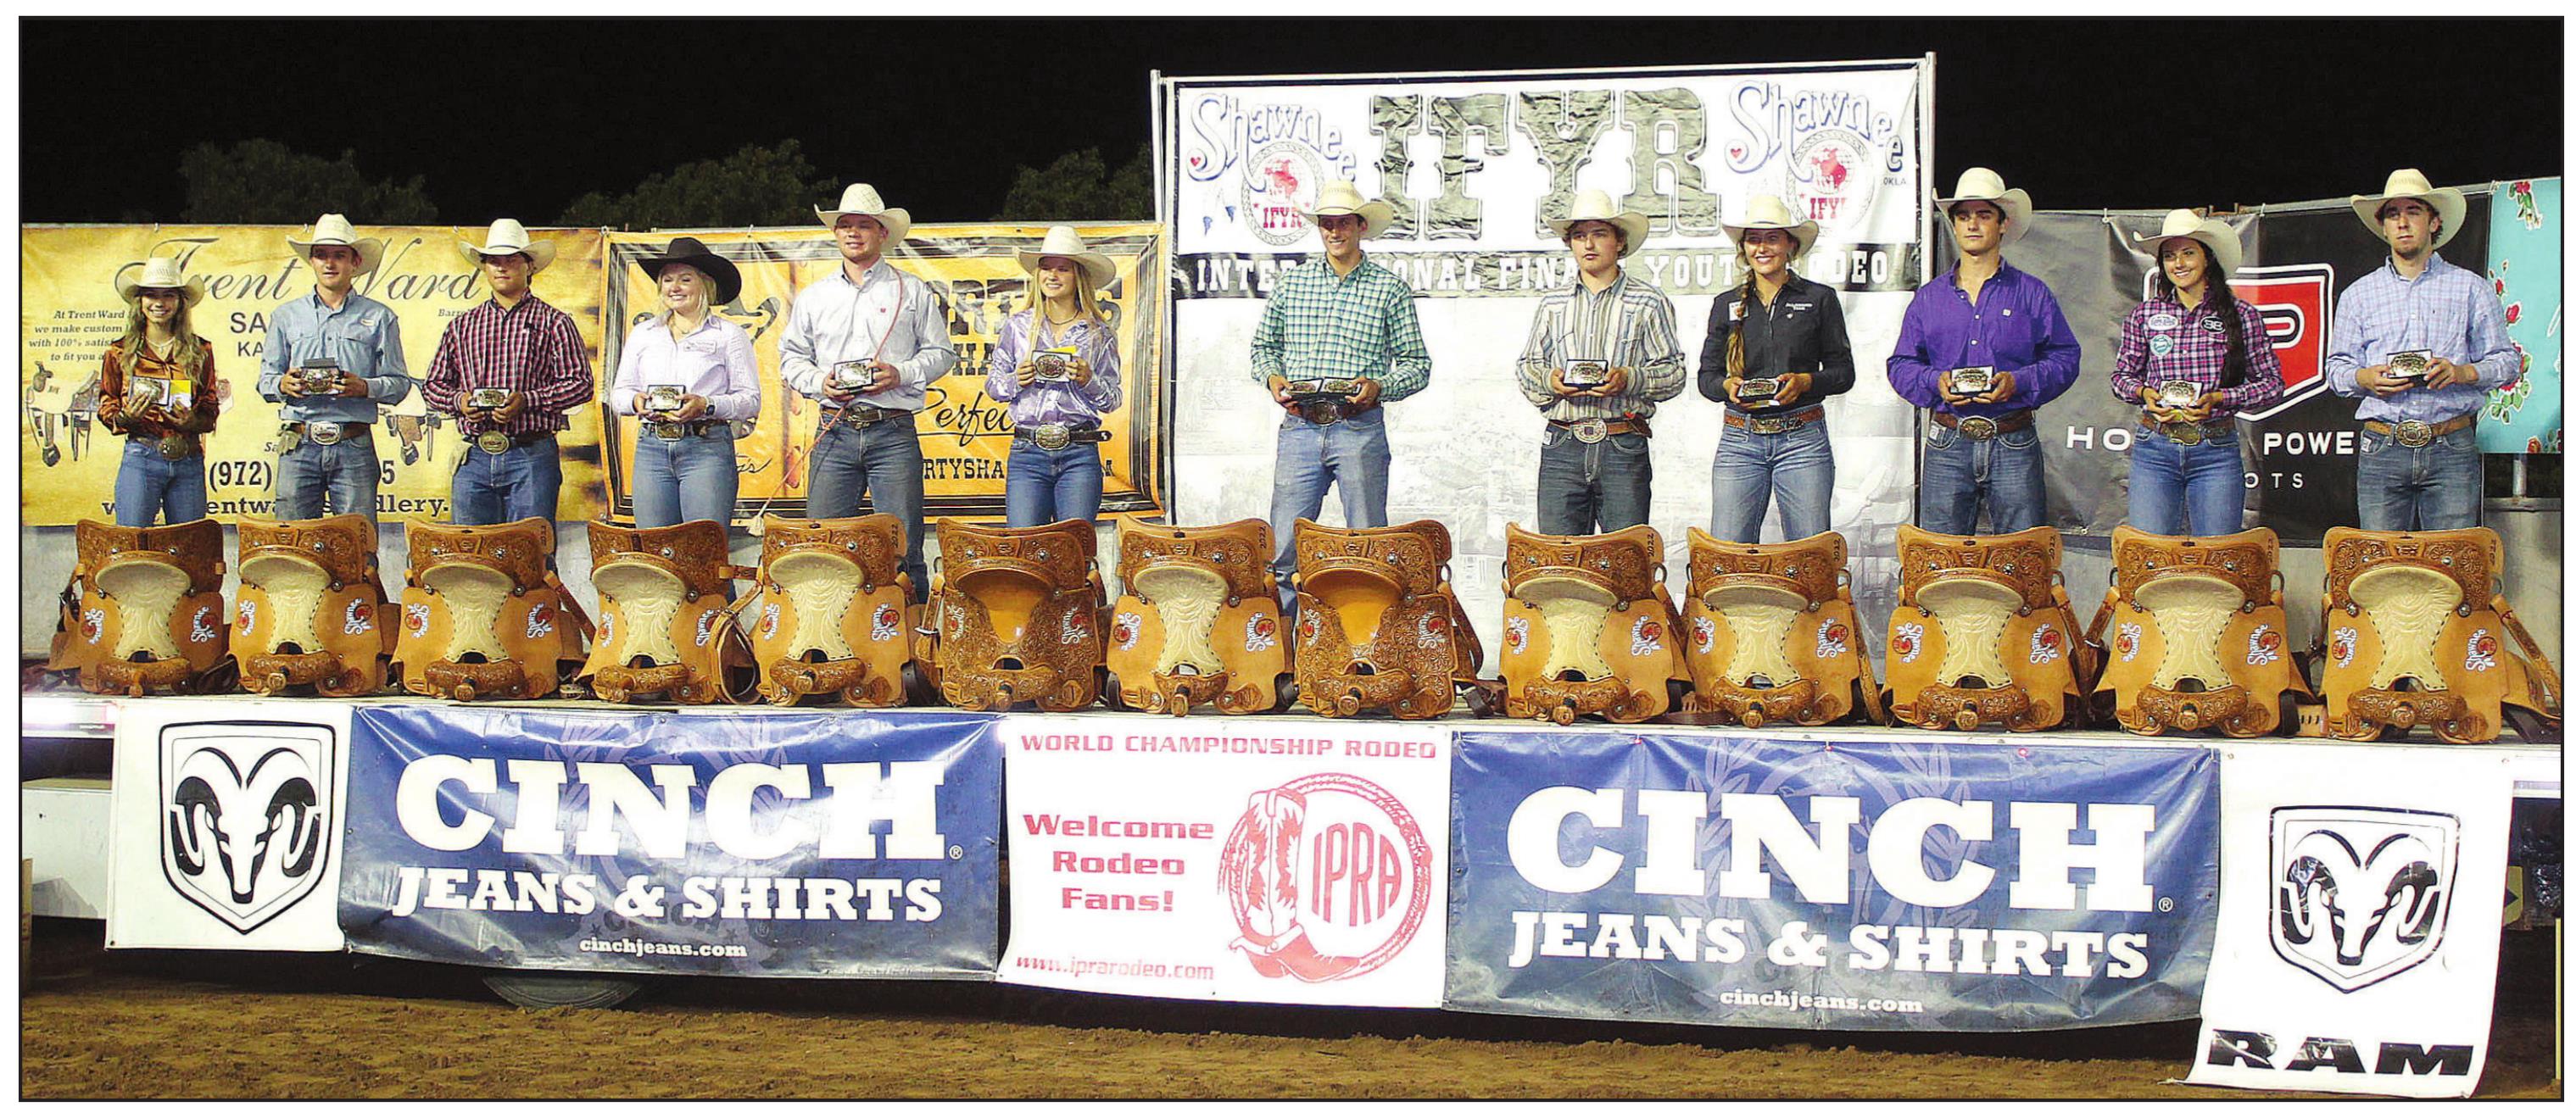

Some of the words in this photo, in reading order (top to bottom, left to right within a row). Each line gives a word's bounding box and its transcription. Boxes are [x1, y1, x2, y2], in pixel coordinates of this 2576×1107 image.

[1187, 92, 1358, 192] Shawnee
[1725, 80, 1903, 183] Shawnee
[1369, 87, 1721, 241] IFYR
[1883, 176, 1907, 186] OKLA
[1263, 207, 1302, 228] IFYR
[1809, 197, 1848, 220] IFY
[1645, 255, 1748, 289] YOUT
[35, 325, 49, 334] we
[52, 324, 81, 334] make
[83, 325, 123, 333] custom
[54, 310, 65, 320] At
[67, 310, 97, 320] Trent
[98, 310, 125, 320] Ward
[29, 338, 52, 348] with
[51, 352, 60, 361] to
[64, 351, 74, 361] fit
[76, 353, 98, 362] you
[209, 460, 272, 492] (972)
[890, 523, 899, 548] 2022
[1631, 615, 1649, 657] Shawnee
[1816, 619, 1837, 659] Shawnee
[2030, 623, 2050, 665] Shawnee
[2247, 623, 2268, 665] Shawnee
[2465, 629, 2485, 672] Shawnee
[1021, 734, 1113, 753] WORLD
[1125, 735, 1333, 756] CHAMPIONSHIP
[1345, 740, 1437, 759] RODEO
[396, 754, 945, 859] CINCH
[1023, 814, 1214, 840] Welcome
[1052, 850, 1185, 876] Rodeo
[1507, 785, 2156, 913] CINCH
[1312, 821, 1402, 927] IPRA
[392, 866, 595, 917] JEANS
[613, 873, 665, 918] &
[681, 876, 942, 923] SHIRTS
[1062, 887, 1174, 912] Fans!
[579, 937, 747, 958] cinchjeans.com
[1508, 910, 1746, 968] JEANS
[1767, 920, 1827, 968] &
[1848, 924, 2149, 979] SHIRTS
[1016, 954, 1214, 981] www.iprarodeo.com
[1719, 987, 1923, 1014] cinchjeans.com
[2207, 1028, 2474, 1076] RAM
